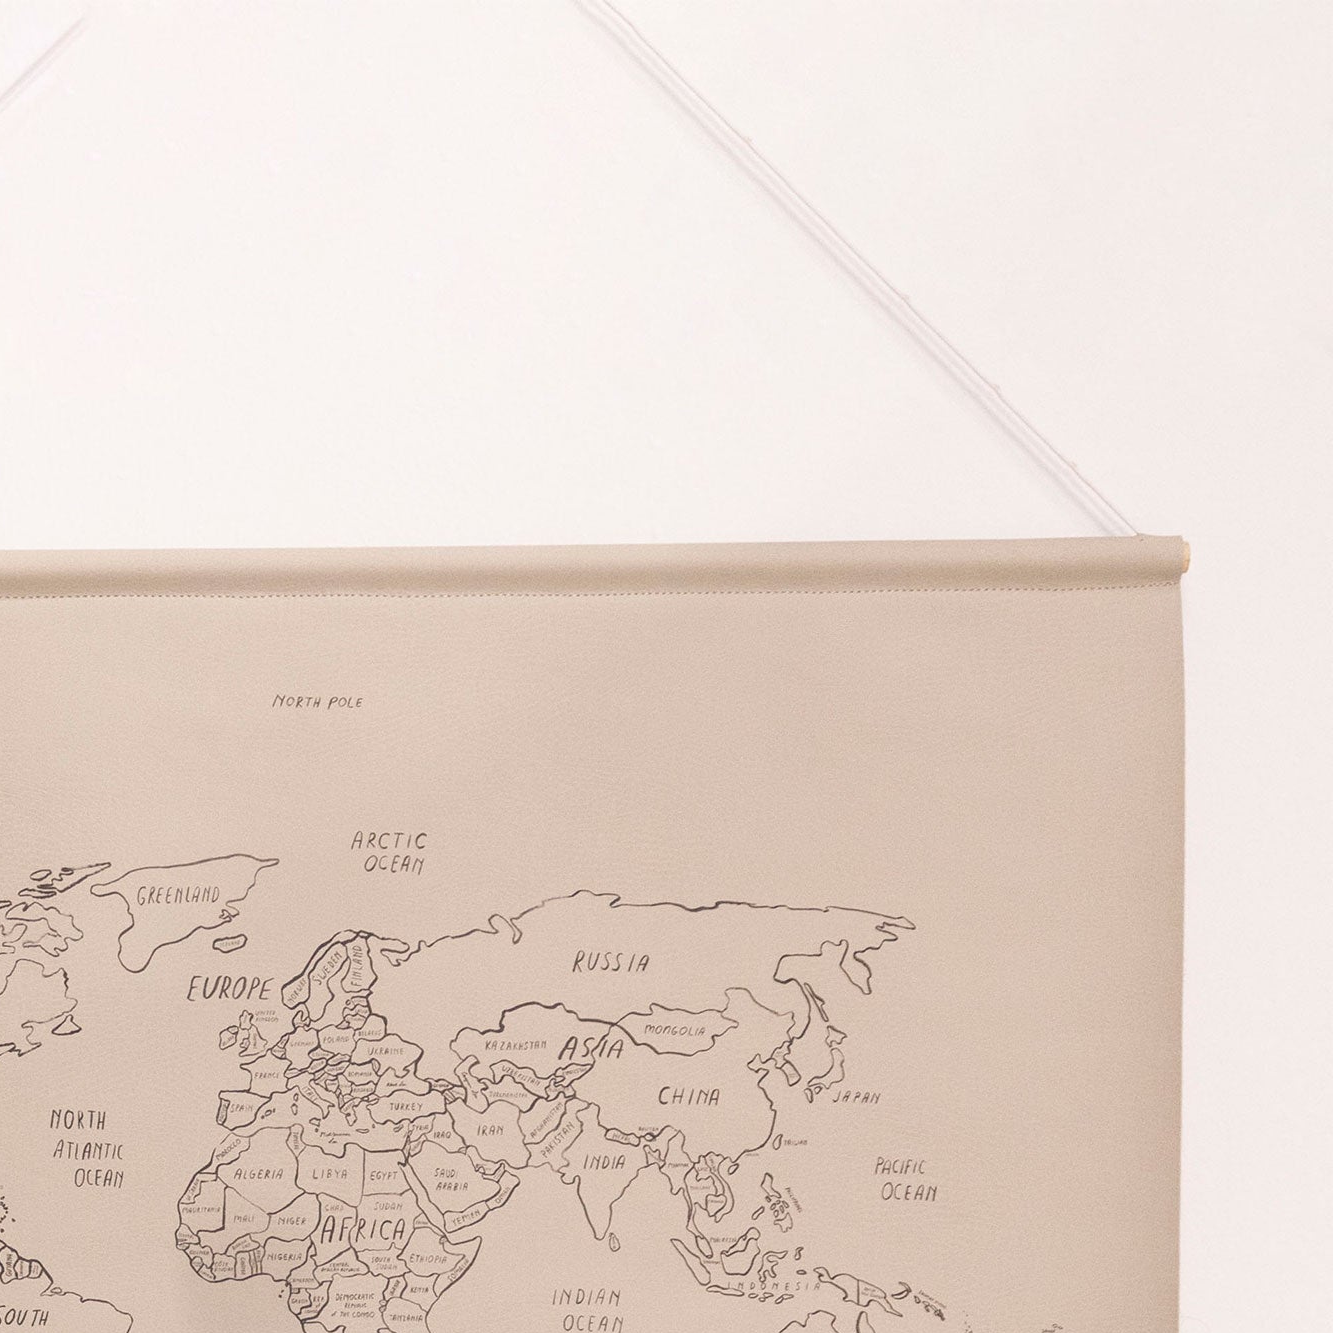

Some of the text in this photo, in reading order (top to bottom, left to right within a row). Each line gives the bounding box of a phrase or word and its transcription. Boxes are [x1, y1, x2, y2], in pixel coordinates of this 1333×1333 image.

[272, 694, 364, 710] NORTH POLE
[351, 831, 427, 851] ARCTIC
[364, 855, 425, 875] OCEAN
[136, 885, 221, 906] GREENLAND
[311, 950, 342, 987] SWEDEN
[351, 944, 364, 988] FINLAND
[572, 950, 651, 973] RUSSIA
[186, 975, 276, 1002] EUROPE
[644, 1023, 706, 1037] MONGOLIA
[484, 1039, 547, 1051] KAZAKHSTAN
[558, 1036, 624, 1061] ASIA
[658, 1086, 720, 1107] CHINA
[832, 1090, 882, 1104] JAPAN
[389, 1102, 423, 1112] TURKEY
[49, 1109, 106, 1131] NORTH
[477, 1123, 505, 1136] IRAN
[541, 1120, 575, 1158] PAKISTAN
[53, 1140, 124, 1161] ATLANTIC
[583, 1154, 626, 1171] INDIA
[874, 1157, 927, 1175] PACIFIC
[74, 1168, 124, 1190] OCEAN
[233, 1167, 284, 1180] ALGERIA
[312, 1168, 348, 1180] LIBYA
[370, 1170, 398, 1181] EGYPT
[433, 1167, 459, 1178] SAUDI
[435, 1181, 469, 1191] ARABIA
[881, 1182, 937, 1201] OCEAN
[451, 1209, 481, 1226] YEMEN
[320, 1215, 406, 1244] AFRICA
[409, 1253, 448, 1265] ETHIOPIA
[551, 1288, 622, 1307] INDIAN
[563, 1315, 624, 1333] OCEAN
